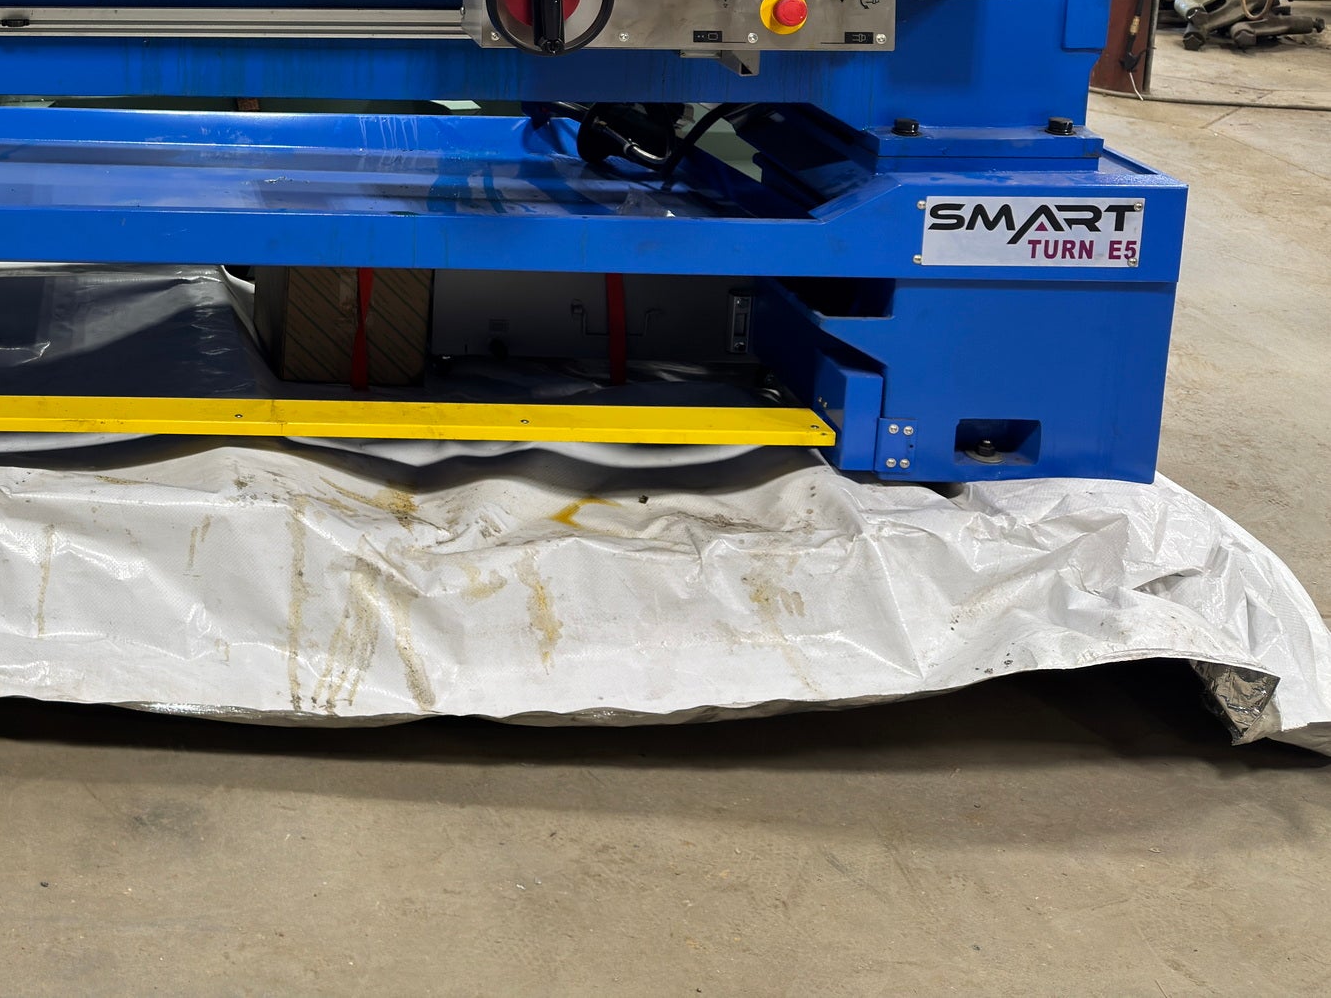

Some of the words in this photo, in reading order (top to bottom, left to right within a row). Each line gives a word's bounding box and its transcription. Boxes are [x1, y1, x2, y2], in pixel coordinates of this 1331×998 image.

[927, 203, 1138, 245] SMART
[1027, 239, 1095, 259] TURN
[1108, 240, 1138, 260] E5
